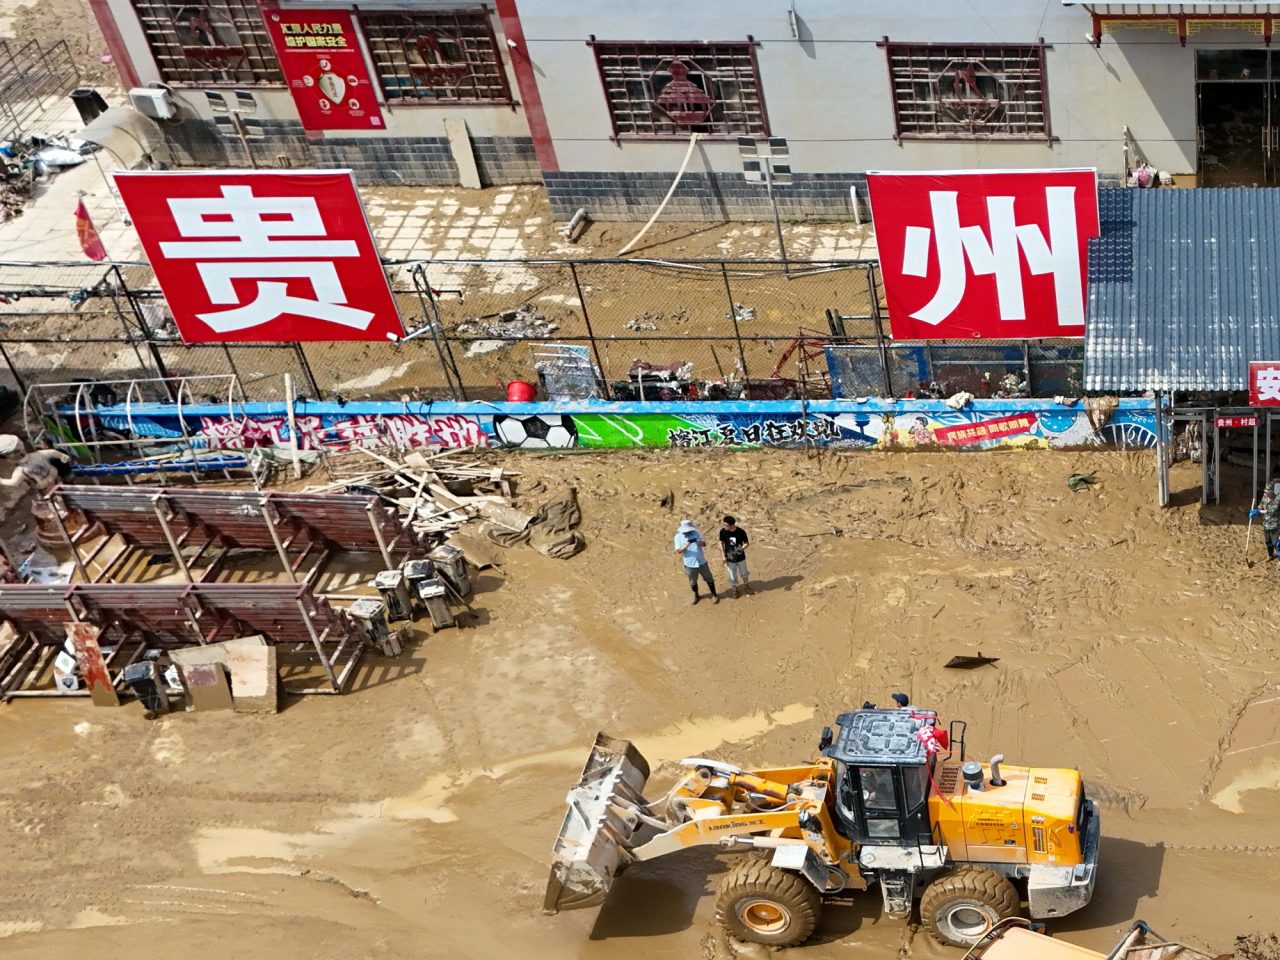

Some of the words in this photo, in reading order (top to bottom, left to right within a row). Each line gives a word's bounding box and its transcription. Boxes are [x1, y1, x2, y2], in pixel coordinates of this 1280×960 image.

[284, 36, 348, 47] 维护国家安全
[158, 184, 376, 334] 贵
[901, 186, 1086, 327] 州
